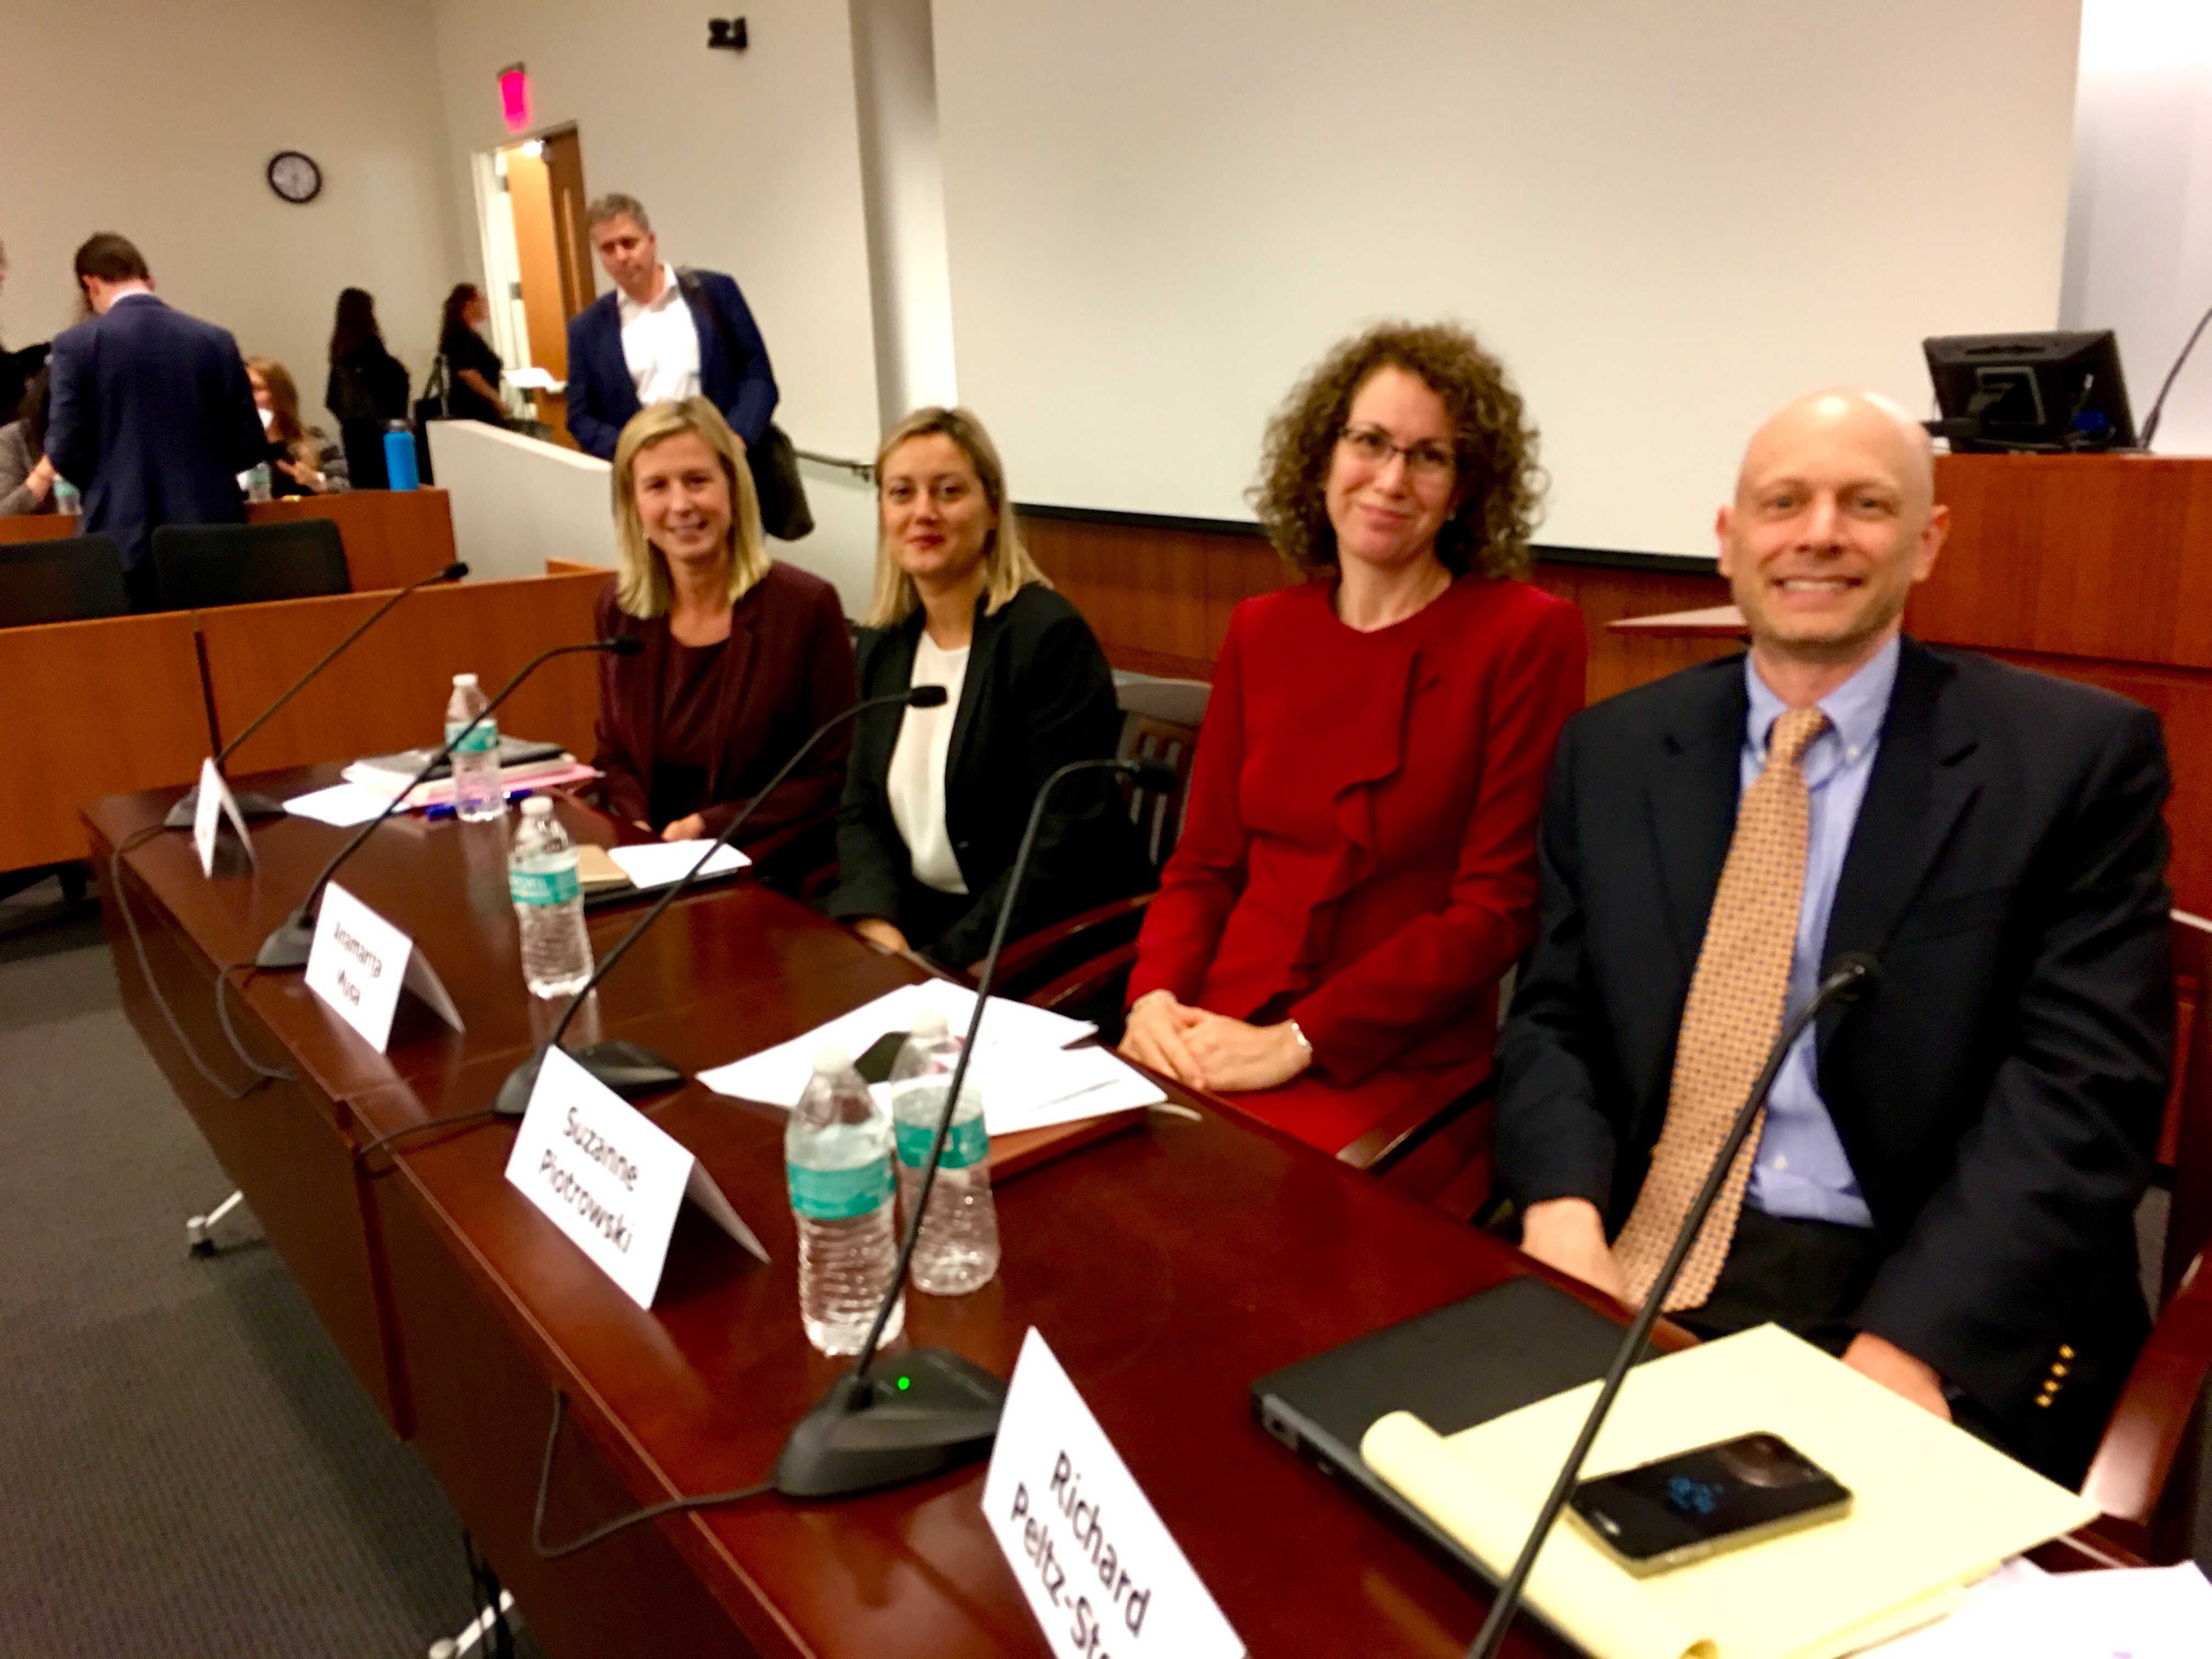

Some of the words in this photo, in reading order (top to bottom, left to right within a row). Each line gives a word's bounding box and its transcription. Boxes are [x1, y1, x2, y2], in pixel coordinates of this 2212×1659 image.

[539, 1148, 636, 1253] Piotrowski
[563, 1105, 639, 1192] Suzanne
[1011, 1482, 1110, 1659] Peltz-St
[1050, 1449, 1151, 1638] Richard
